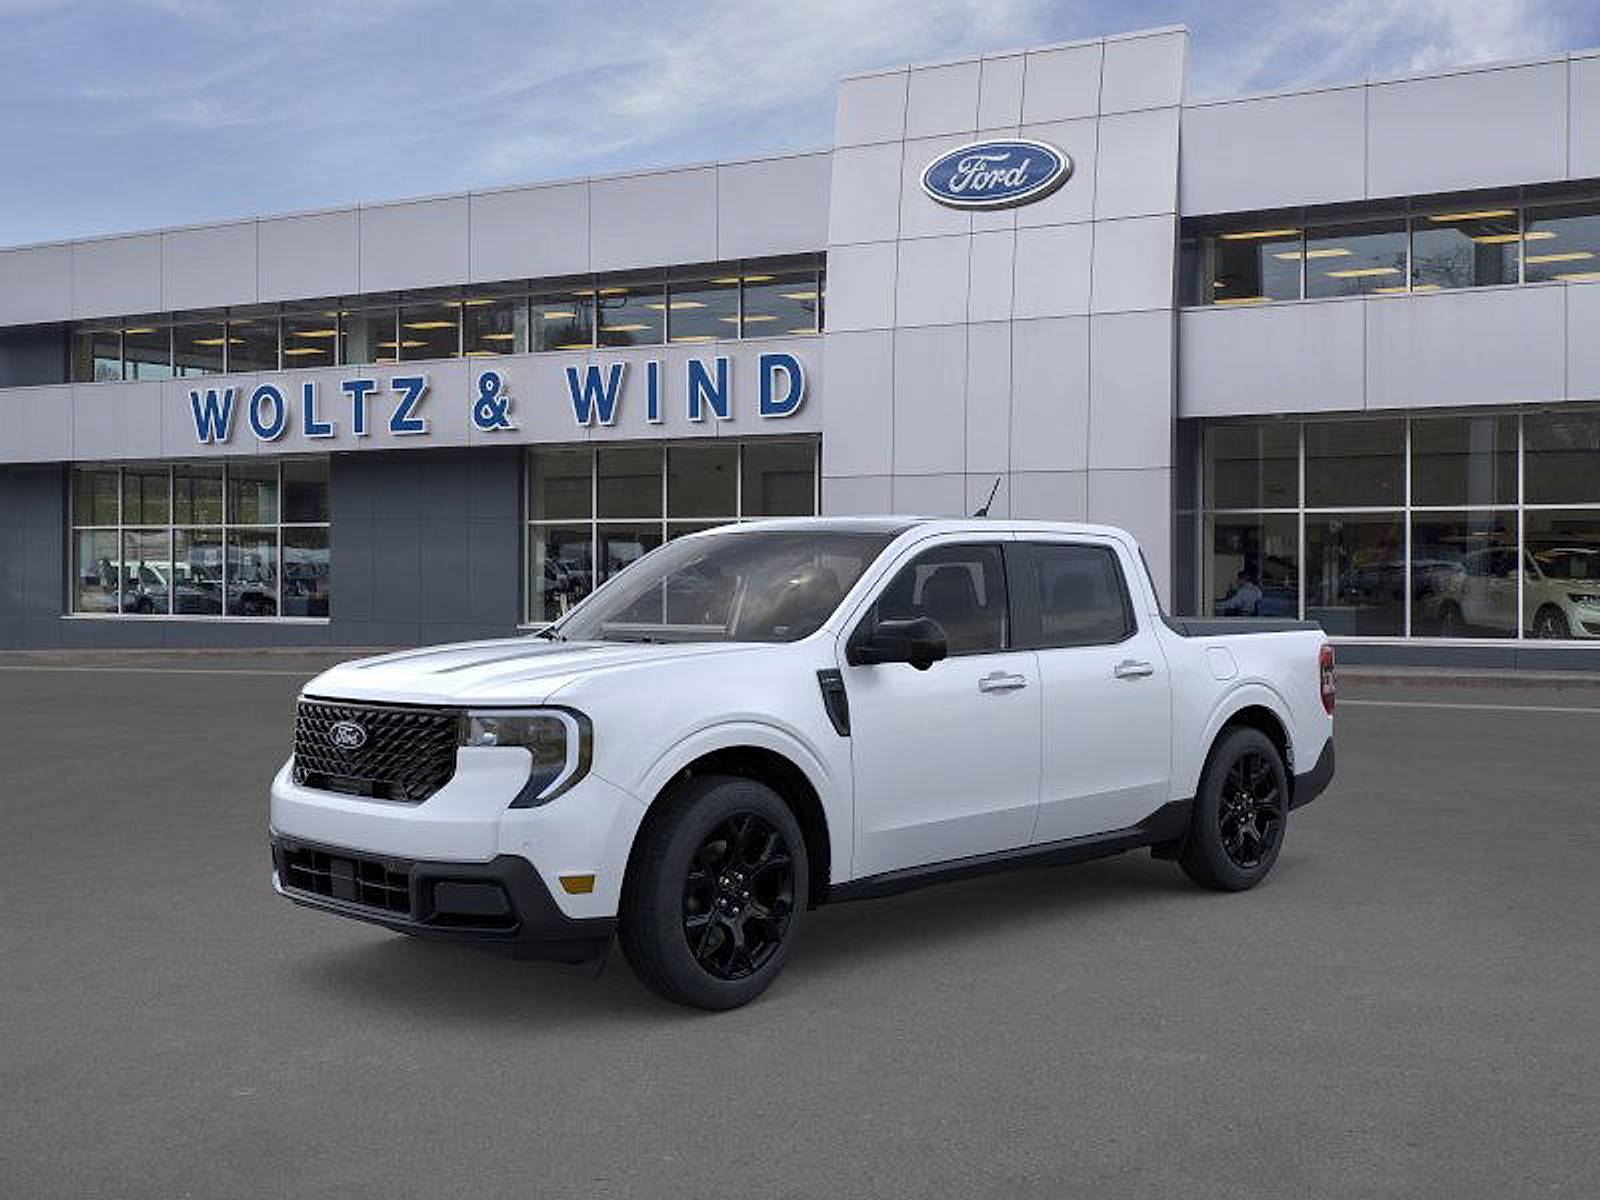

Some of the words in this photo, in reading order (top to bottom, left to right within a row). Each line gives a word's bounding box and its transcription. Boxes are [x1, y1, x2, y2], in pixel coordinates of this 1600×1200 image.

[949, 152, 1031, 193] Ford
[190, 375, 428, 444] WOLTZ
[472, 371, 516, 432] &
[565, 352, 807, 427] WIND
